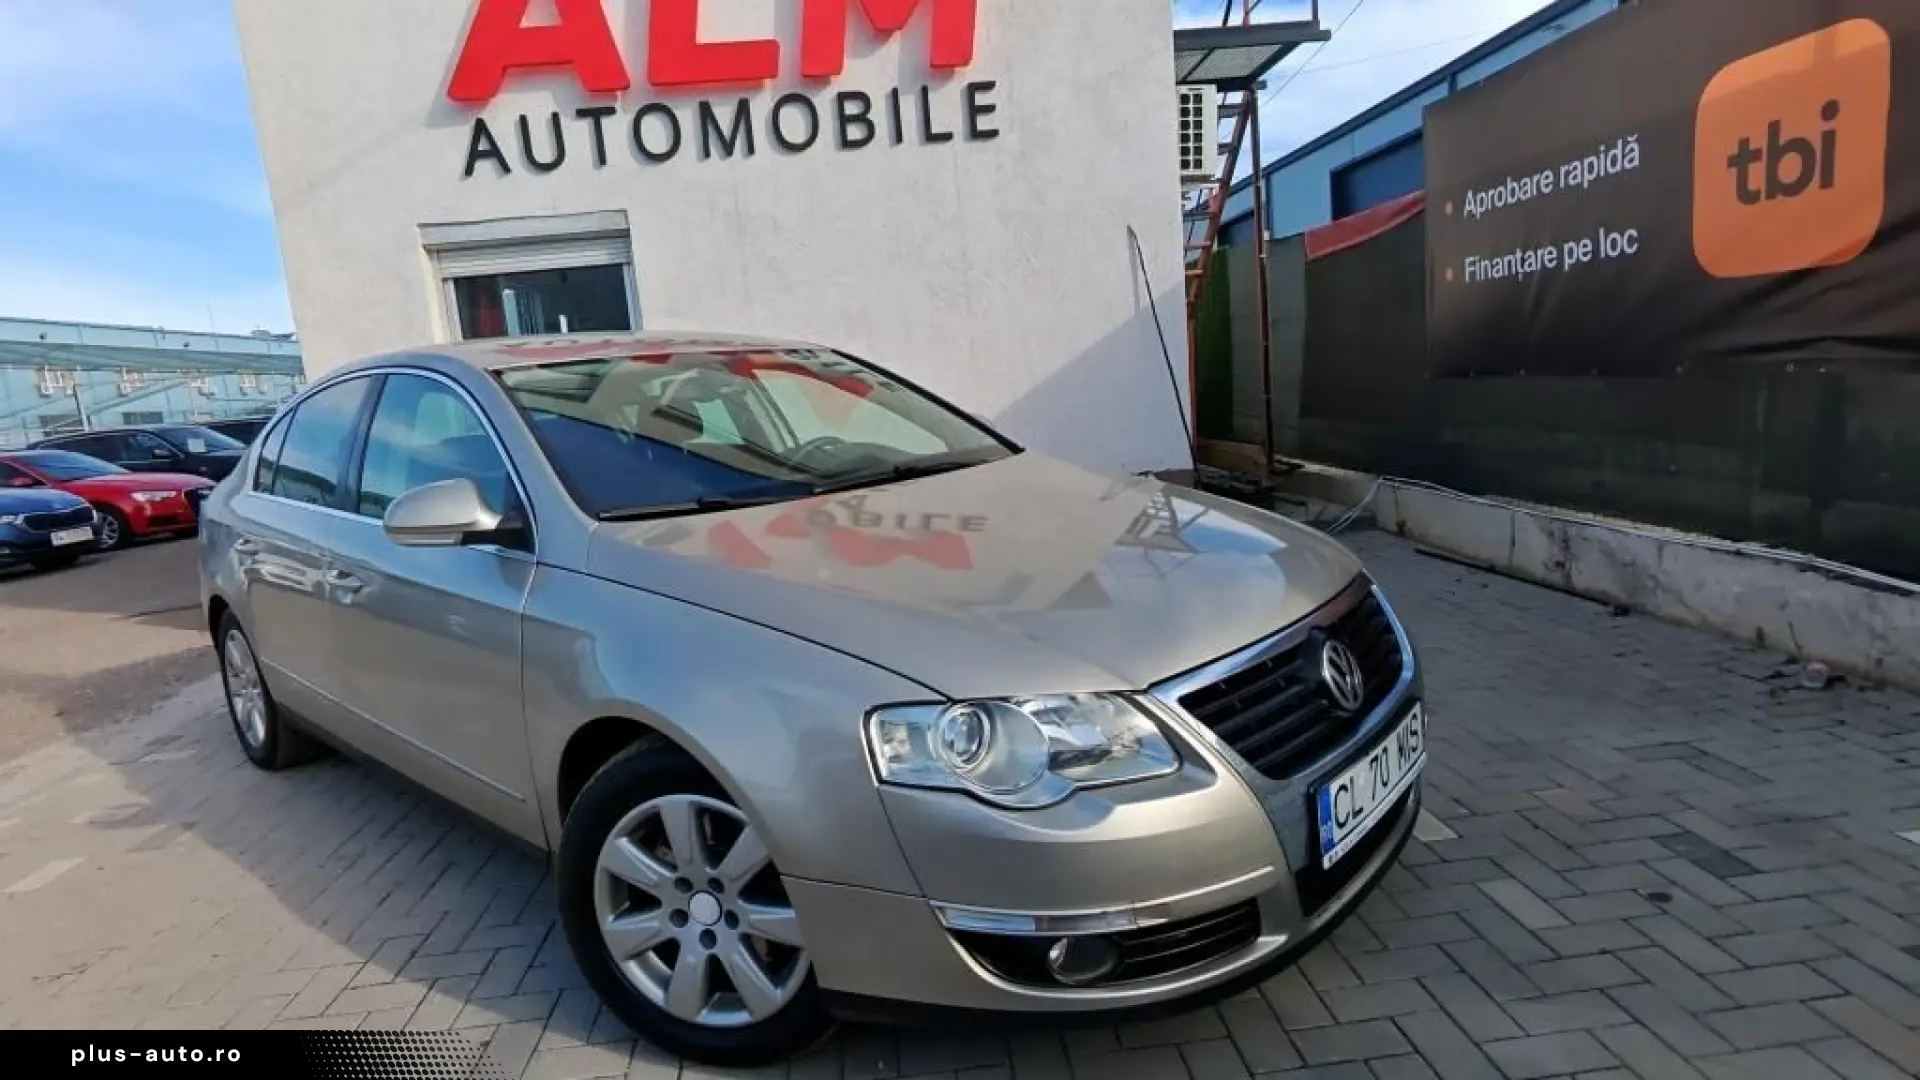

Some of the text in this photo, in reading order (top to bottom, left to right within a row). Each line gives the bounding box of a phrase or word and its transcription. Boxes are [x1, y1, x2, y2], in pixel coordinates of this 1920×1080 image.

[464, 81, 1000, 177] AUTOMOBILE
[1464, 133, 1640, 220] Aprobare rapidă
[1727, 99, 1840, 205] tbi
[1464, 227, 1639, 283] Finanțare pe loc
[1333, 776, 1364, 830] CL
[1368, 746, 1390, 802] 70
[1396, 711, 1419, 767] MIS
